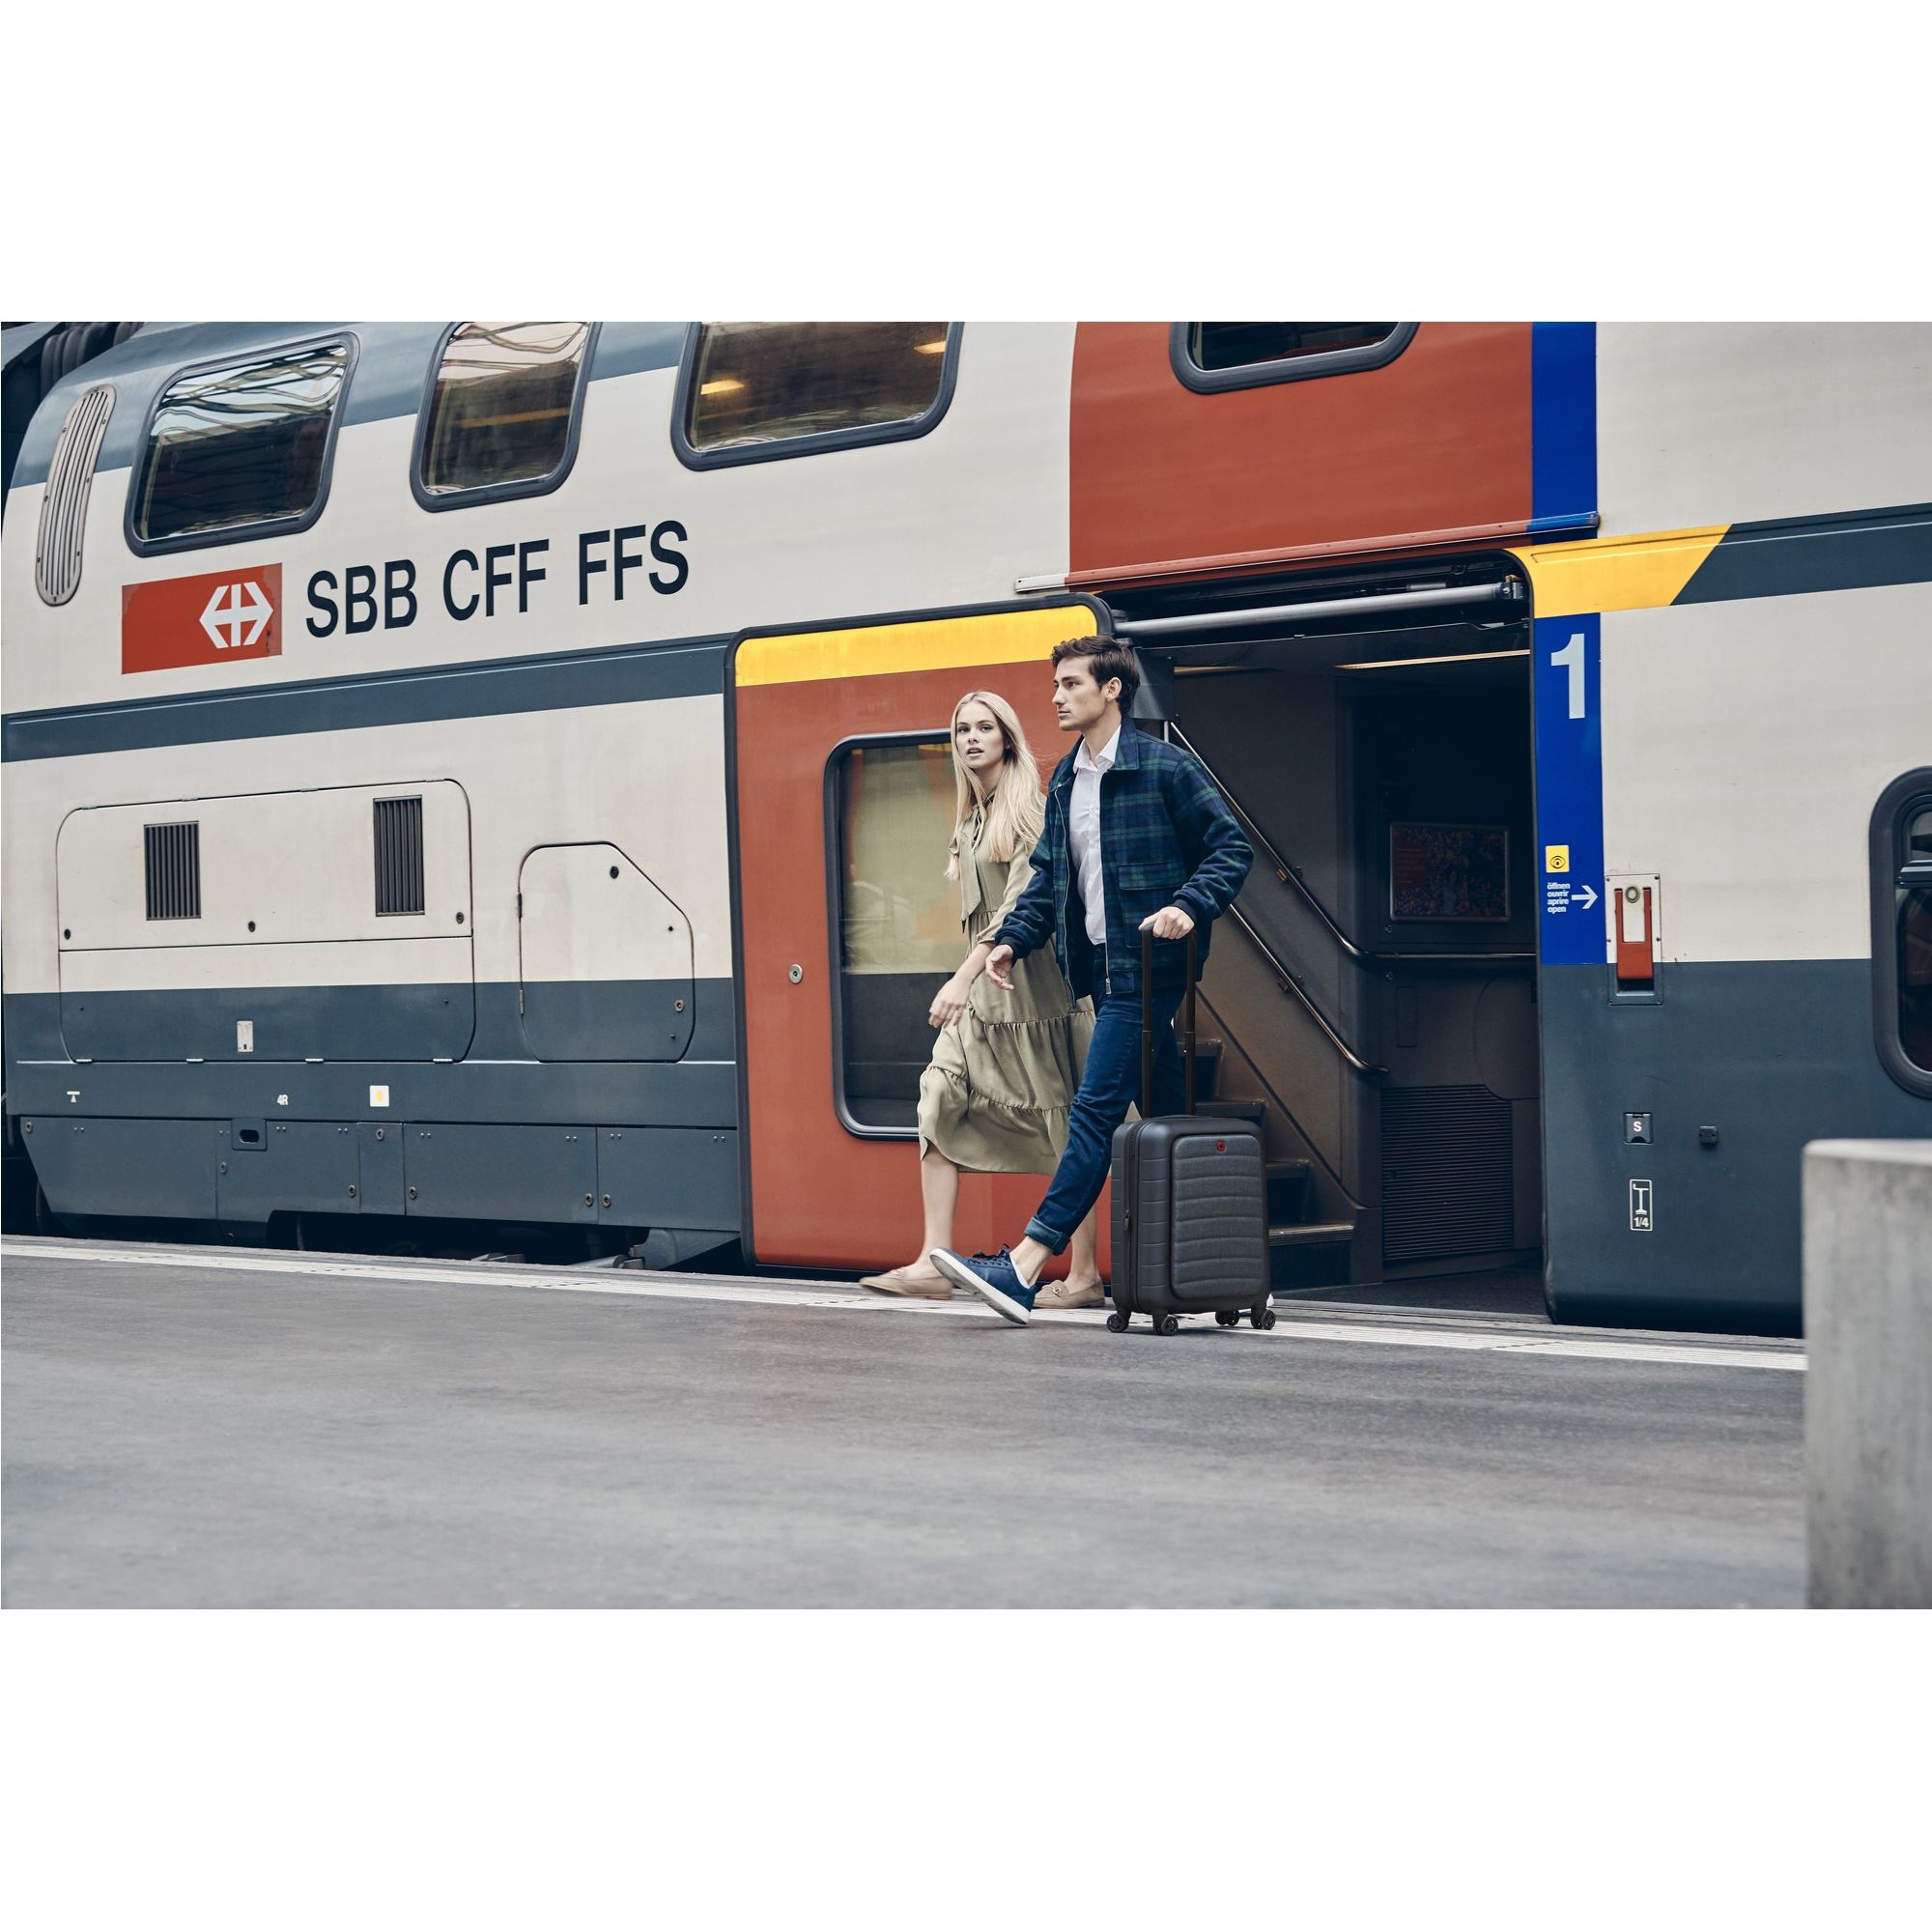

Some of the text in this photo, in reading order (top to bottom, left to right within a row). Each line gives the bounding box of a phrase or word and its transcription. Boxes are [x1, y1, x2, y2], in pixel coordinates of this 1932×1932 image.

[305, 520, 690, 638] SBB CFF FFS
[1550, 633, 1585, 719] 1
[1547, 897, 1570, 906] aprire
[1633, 1121, 1642, 1132] S
[1634, 1217, 1649, 1228] 1/4
